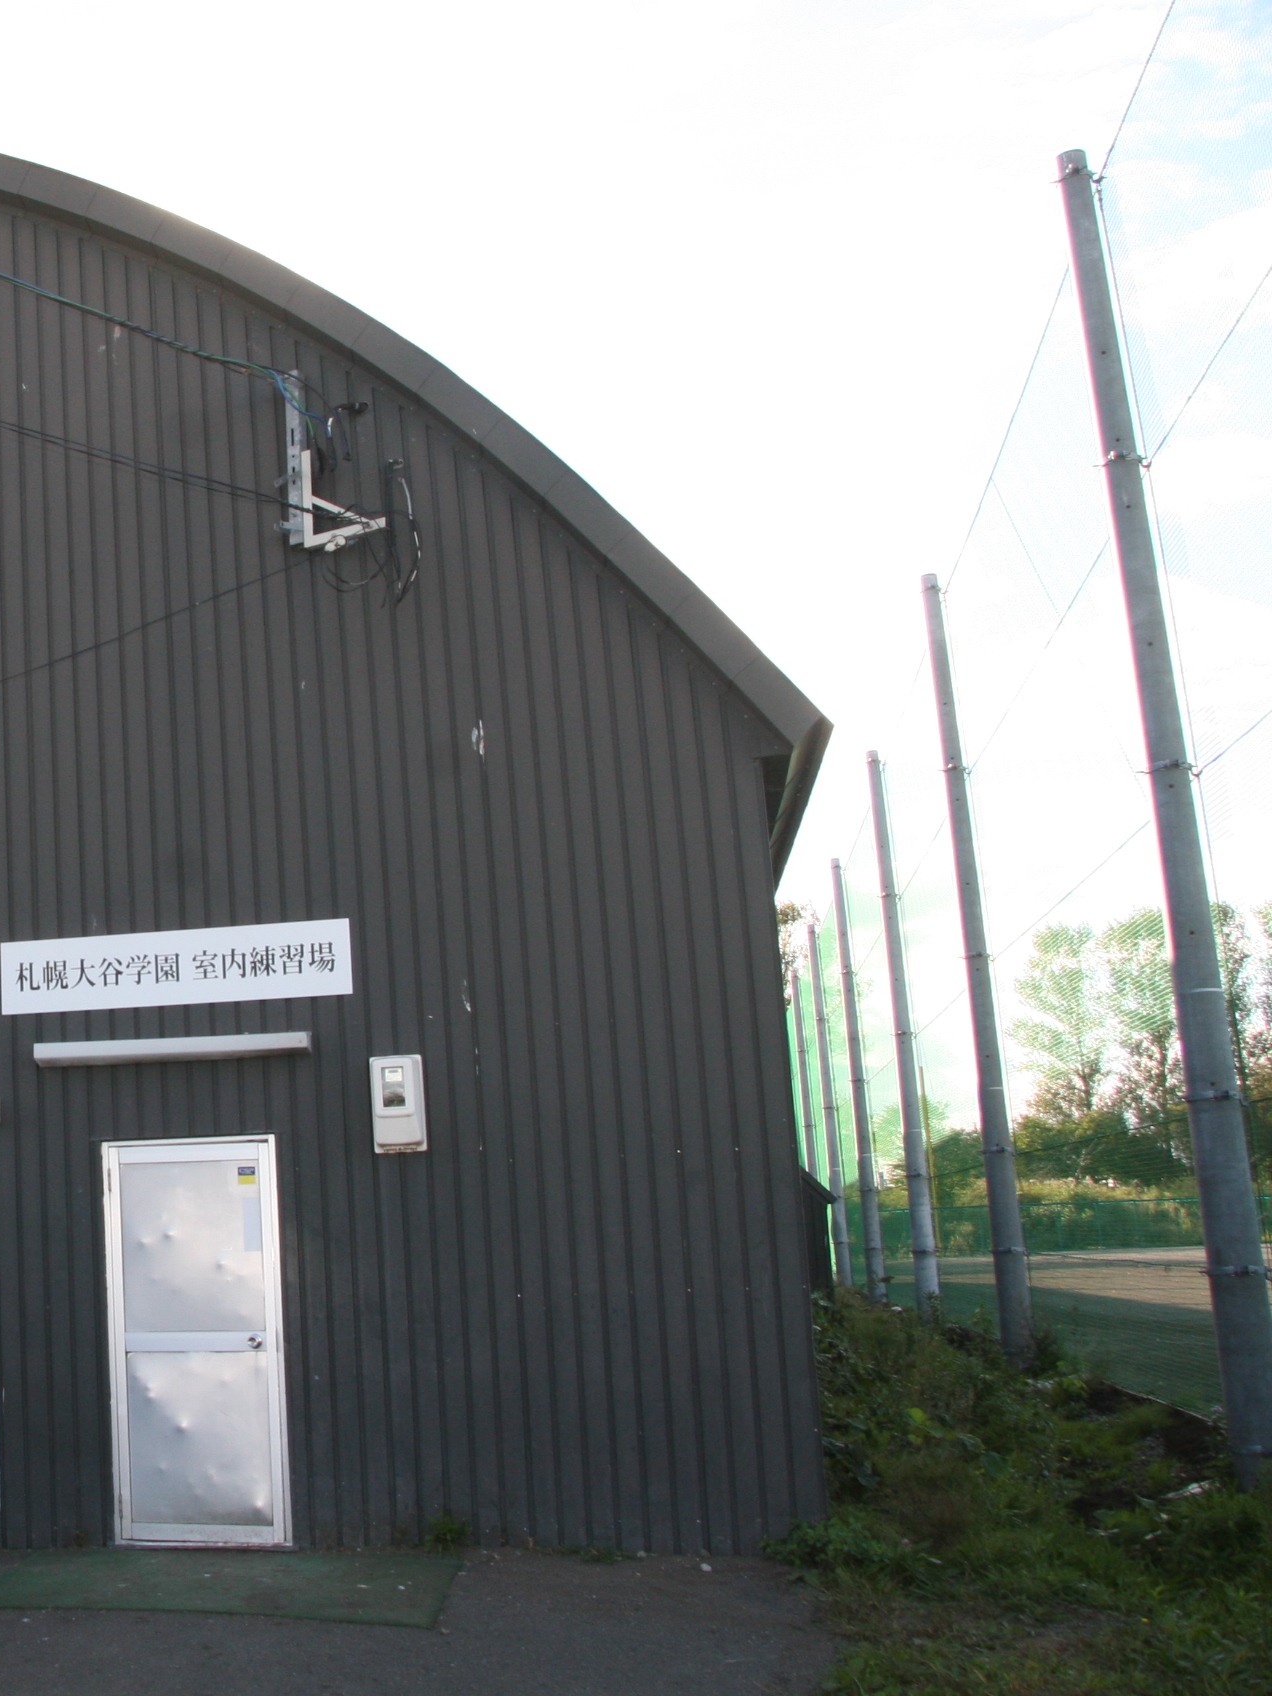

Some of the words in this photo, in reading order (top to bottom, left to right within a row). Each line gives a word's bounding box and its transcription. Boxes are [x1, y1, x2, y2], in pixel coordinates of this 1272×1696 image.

[15, 951, 181, 992] 札幌大谷学園
[192, 941, 336, 981] 室内練習場
